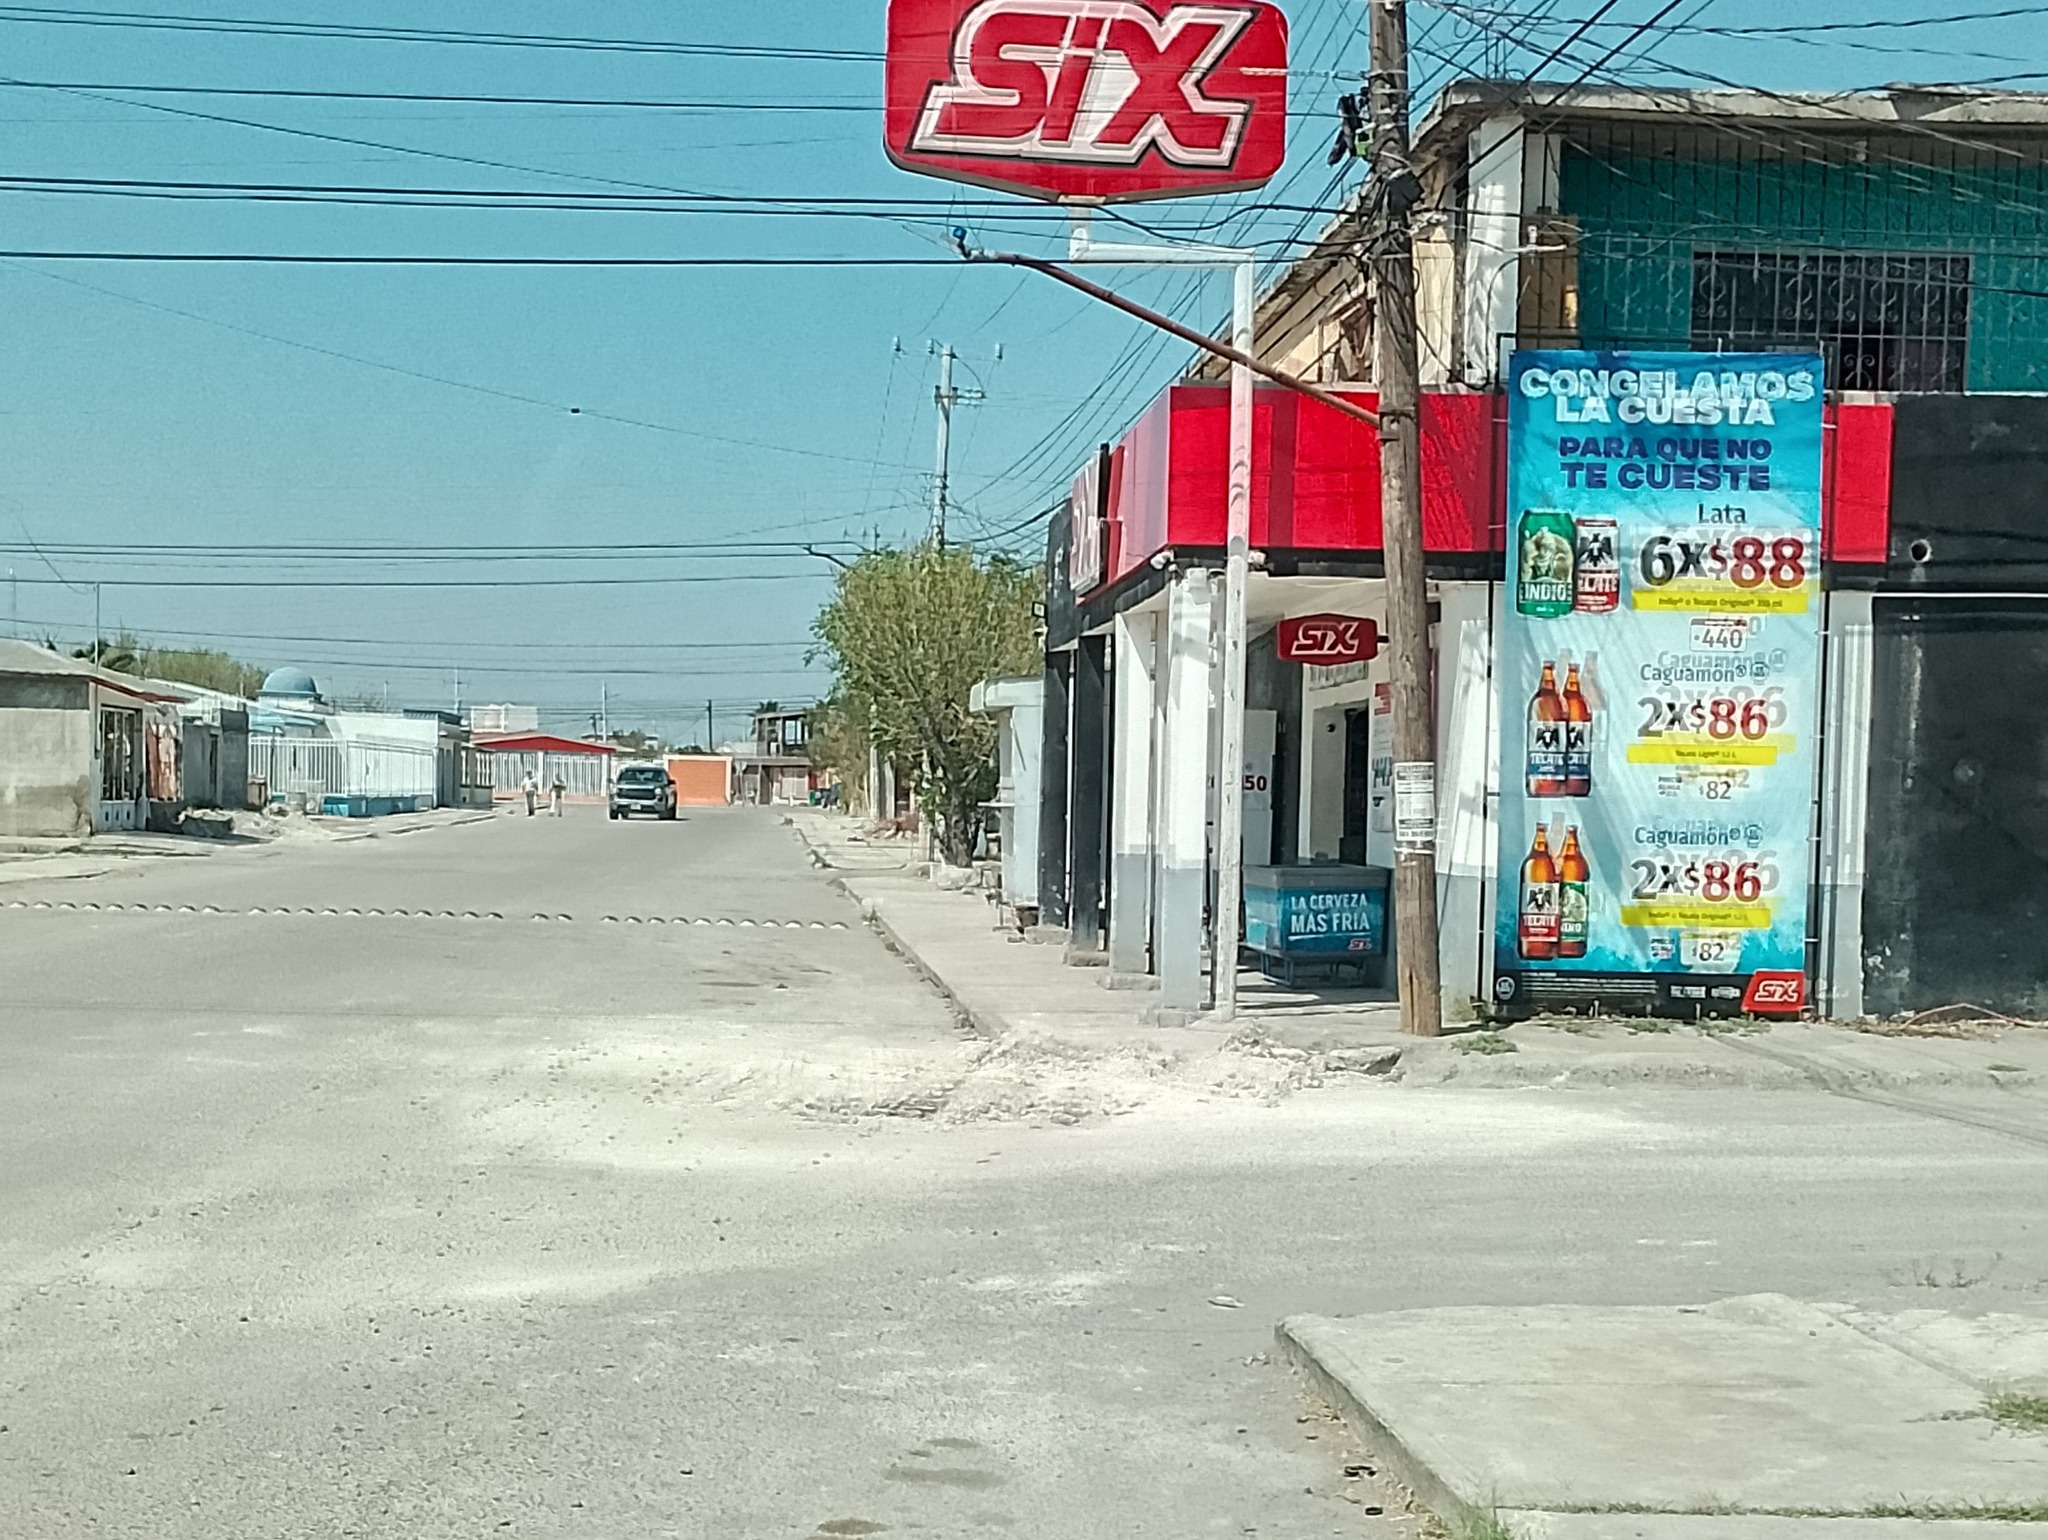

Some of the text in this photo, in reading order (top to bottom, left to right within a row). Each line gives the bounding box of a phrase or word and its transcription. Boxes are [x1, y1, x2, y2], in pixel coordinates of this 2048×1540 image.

[1519, 368, 1816, 401] CONGELAMOS
[1556, 397, 1776, 426] LA CUESTA
[1559, 437, 1772, 462] PARA QUE NO
[1560, 462, 1771, 492] TE CUESTE
[1698, 504, 1747, 524] Lata
[1524, 583, 1566, 601] INDIO
[1291, 893, 1368, 911] LA CERVEZA
[1754, 980, 1799, 1002] SIX
